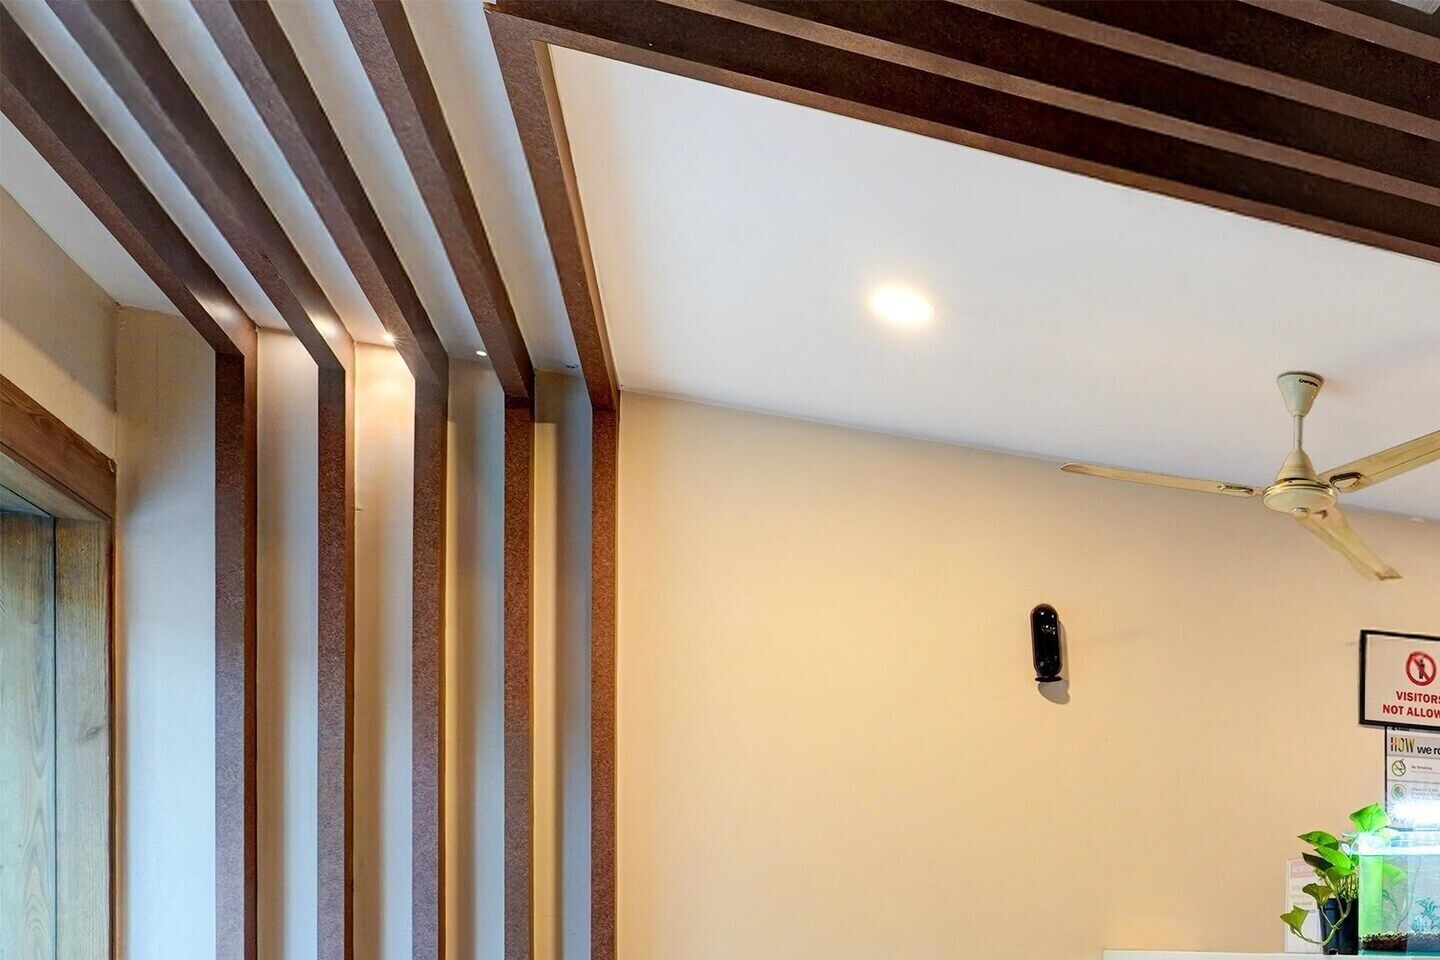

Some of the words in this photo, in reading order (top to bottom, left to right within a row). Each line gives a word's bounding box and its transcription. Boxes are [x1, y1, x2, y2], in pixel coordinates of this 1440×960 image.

[1382, 704, 1404, 714] NOT
[1390, 736, 1415, 754] HOW
[1416, 746, 1432, 755] we
